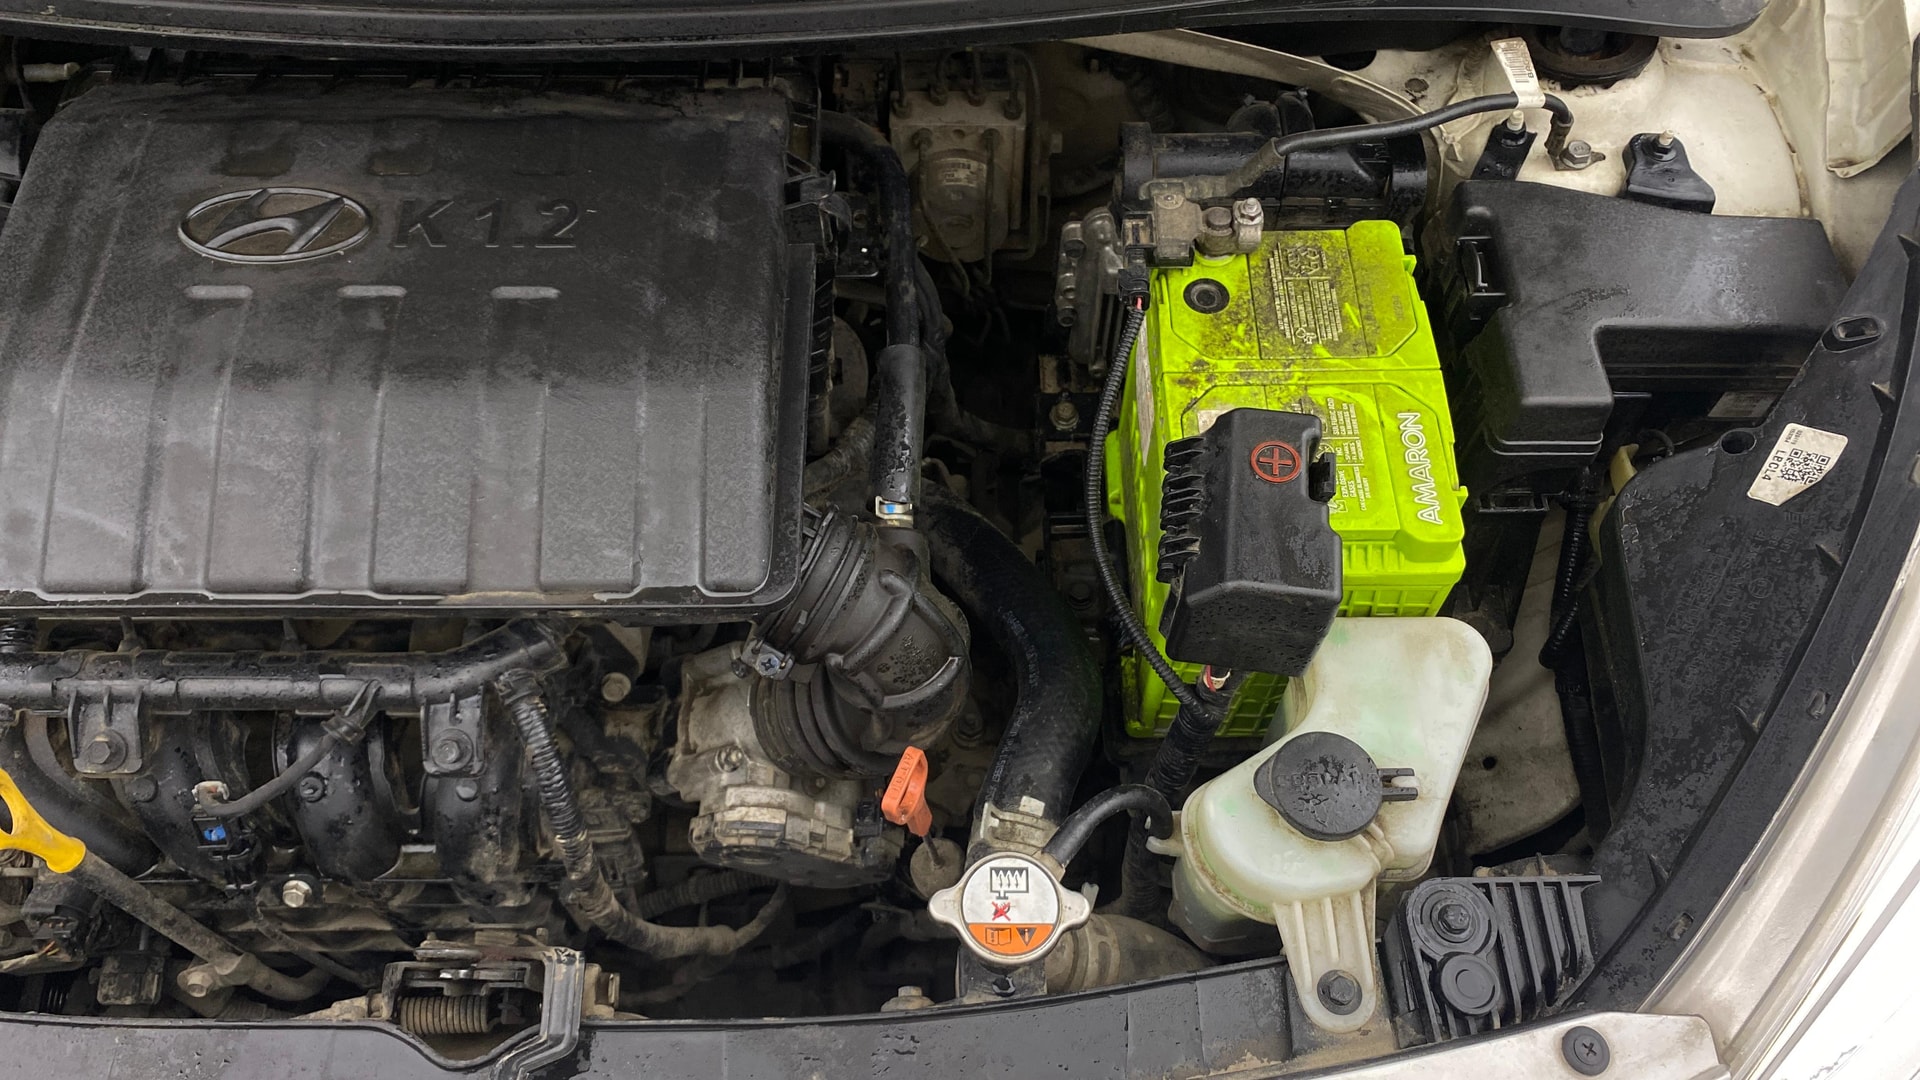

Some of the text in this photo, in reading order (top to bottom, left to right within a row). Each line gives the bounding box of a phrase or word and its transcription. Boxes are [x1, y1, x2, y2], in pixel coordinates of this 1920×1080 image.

[394, 199, 455, 248] K
[1327, 397, 1340, 435] SULFURIC ACID
[1337, 410, 1345, 425] CAUSE
[1336, 447, 1343, 456] NO
[1338, 470, 1348, 498] EXPLOSIVE
[1397, 412, 1443, 525] AMARON
